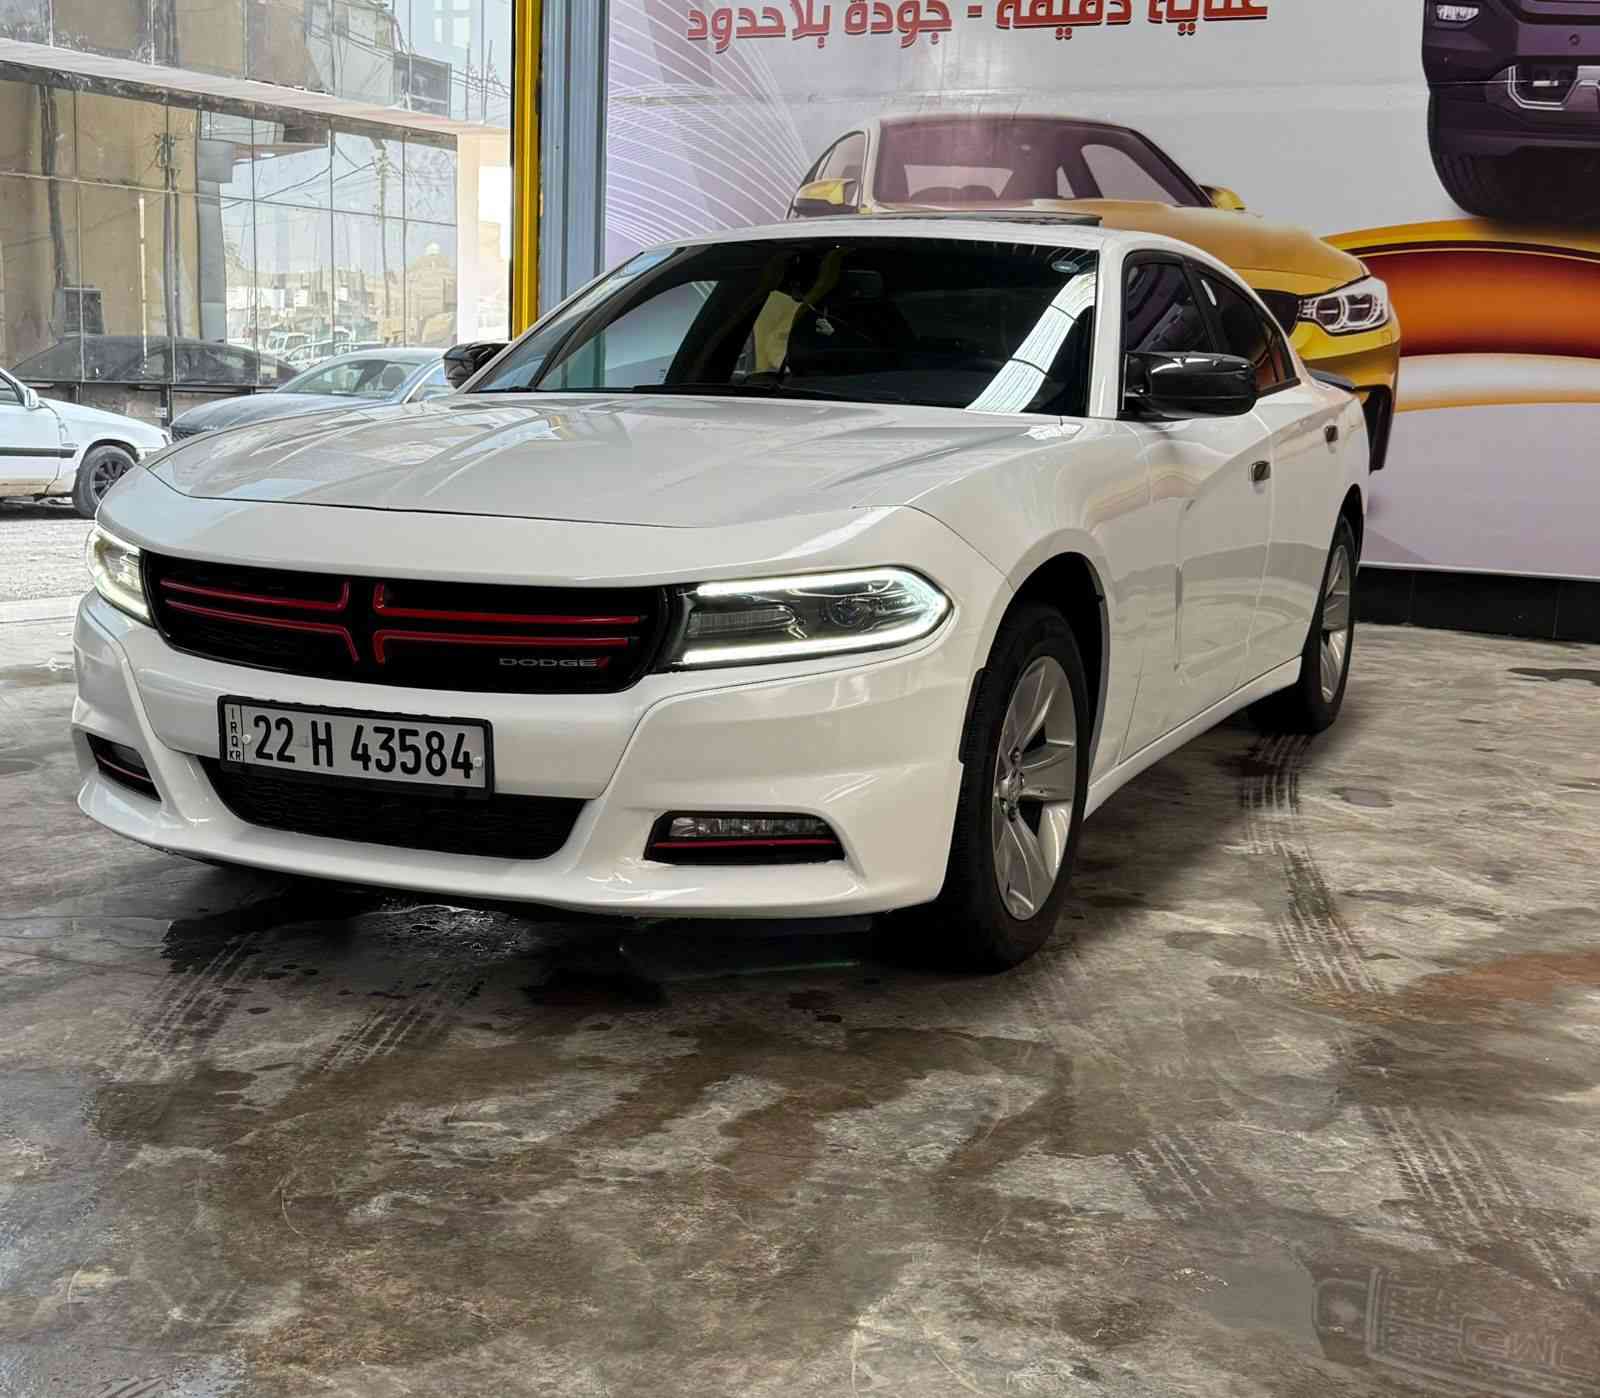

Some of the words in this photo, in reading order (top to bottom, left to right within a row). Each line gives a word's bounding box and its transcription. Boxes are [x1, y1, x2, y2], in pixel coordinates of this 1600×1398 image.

[844, 0, 953, 48] جودة
[499, 658, 598, 667] DODGE
[253, 714, 295, 763] 22
[311, 720, 334, 767] H
[351, 724, 474, 779] 43584
